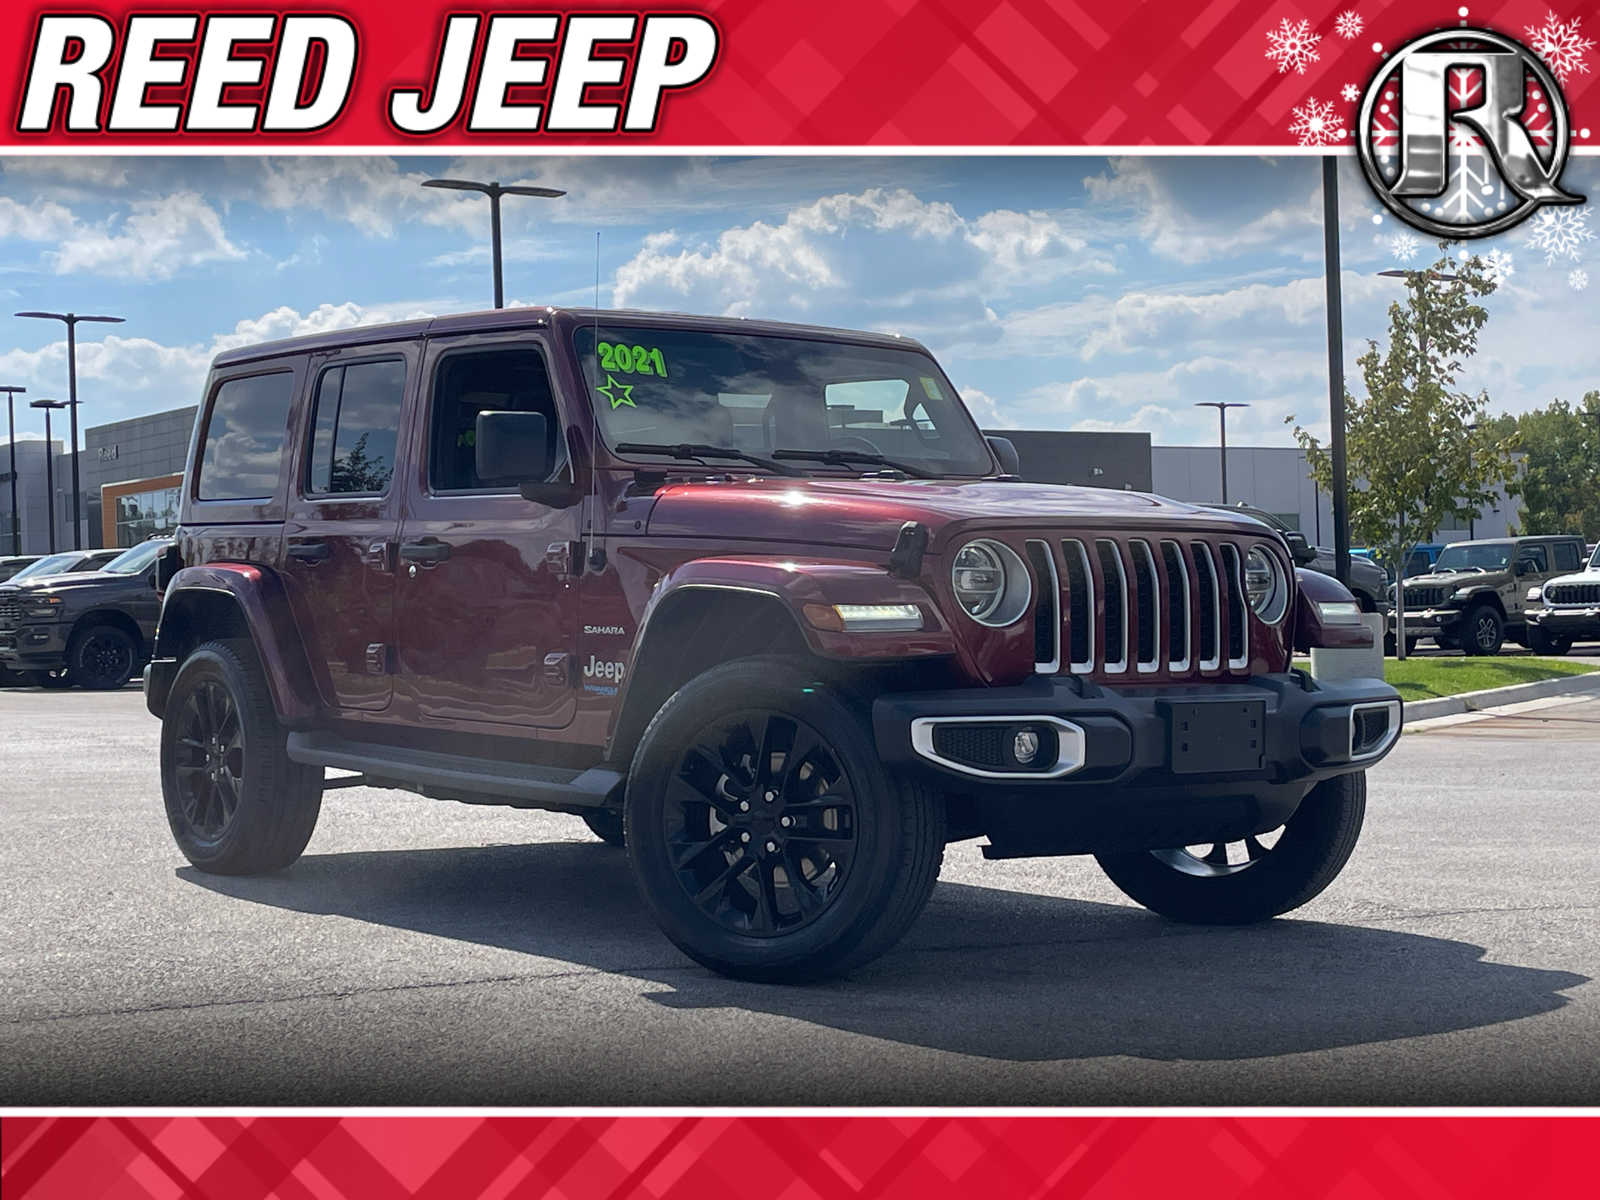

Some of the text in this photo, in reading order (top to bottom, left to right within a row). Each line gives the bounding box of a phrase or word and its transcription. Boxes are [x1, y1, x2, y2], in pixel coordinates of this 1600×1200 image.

[598, 342, 668, 378] 2021
[583, 625, 625, 635] SAHARA
[583, 655, 625, 683] Jeep
